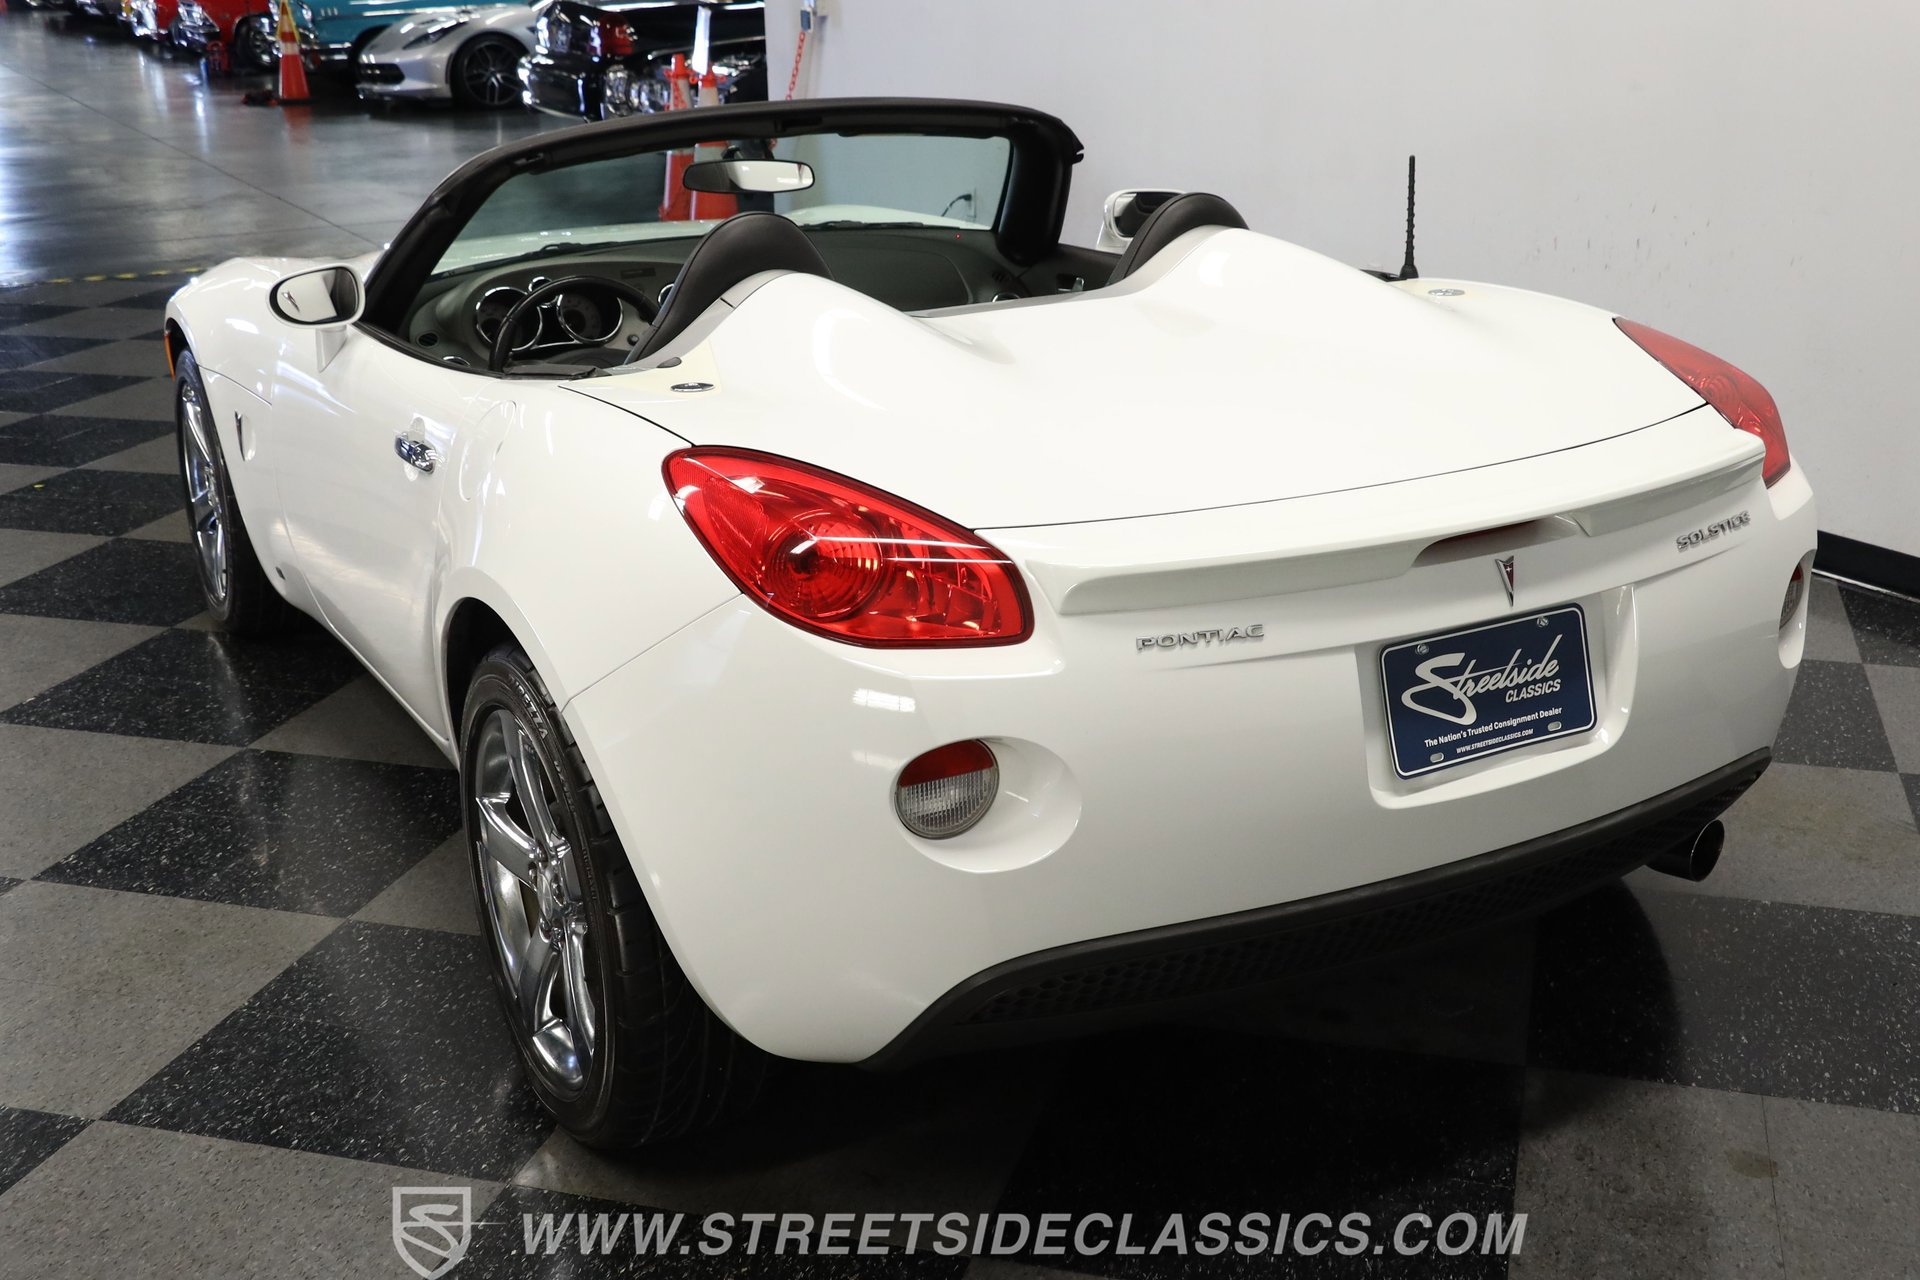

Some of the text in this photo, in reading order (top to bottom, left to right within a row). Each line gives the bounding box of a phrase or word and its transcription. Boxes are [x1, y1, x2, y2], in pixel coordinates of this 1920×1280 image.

[1676, 510, 1751, 549] SOLSTICE
[1136, 624, 1265, 650] PONTIAC
[1401, 634, 1563, 726] Streetside
[1505, 679, 1562, 703] CLASSICS
[1424, 707, 1562, 748] The Nation's Trusted Consignment Dealer
[1456, 728, 1534, 754] WWW.STREETSIDECLASSICS.COM
